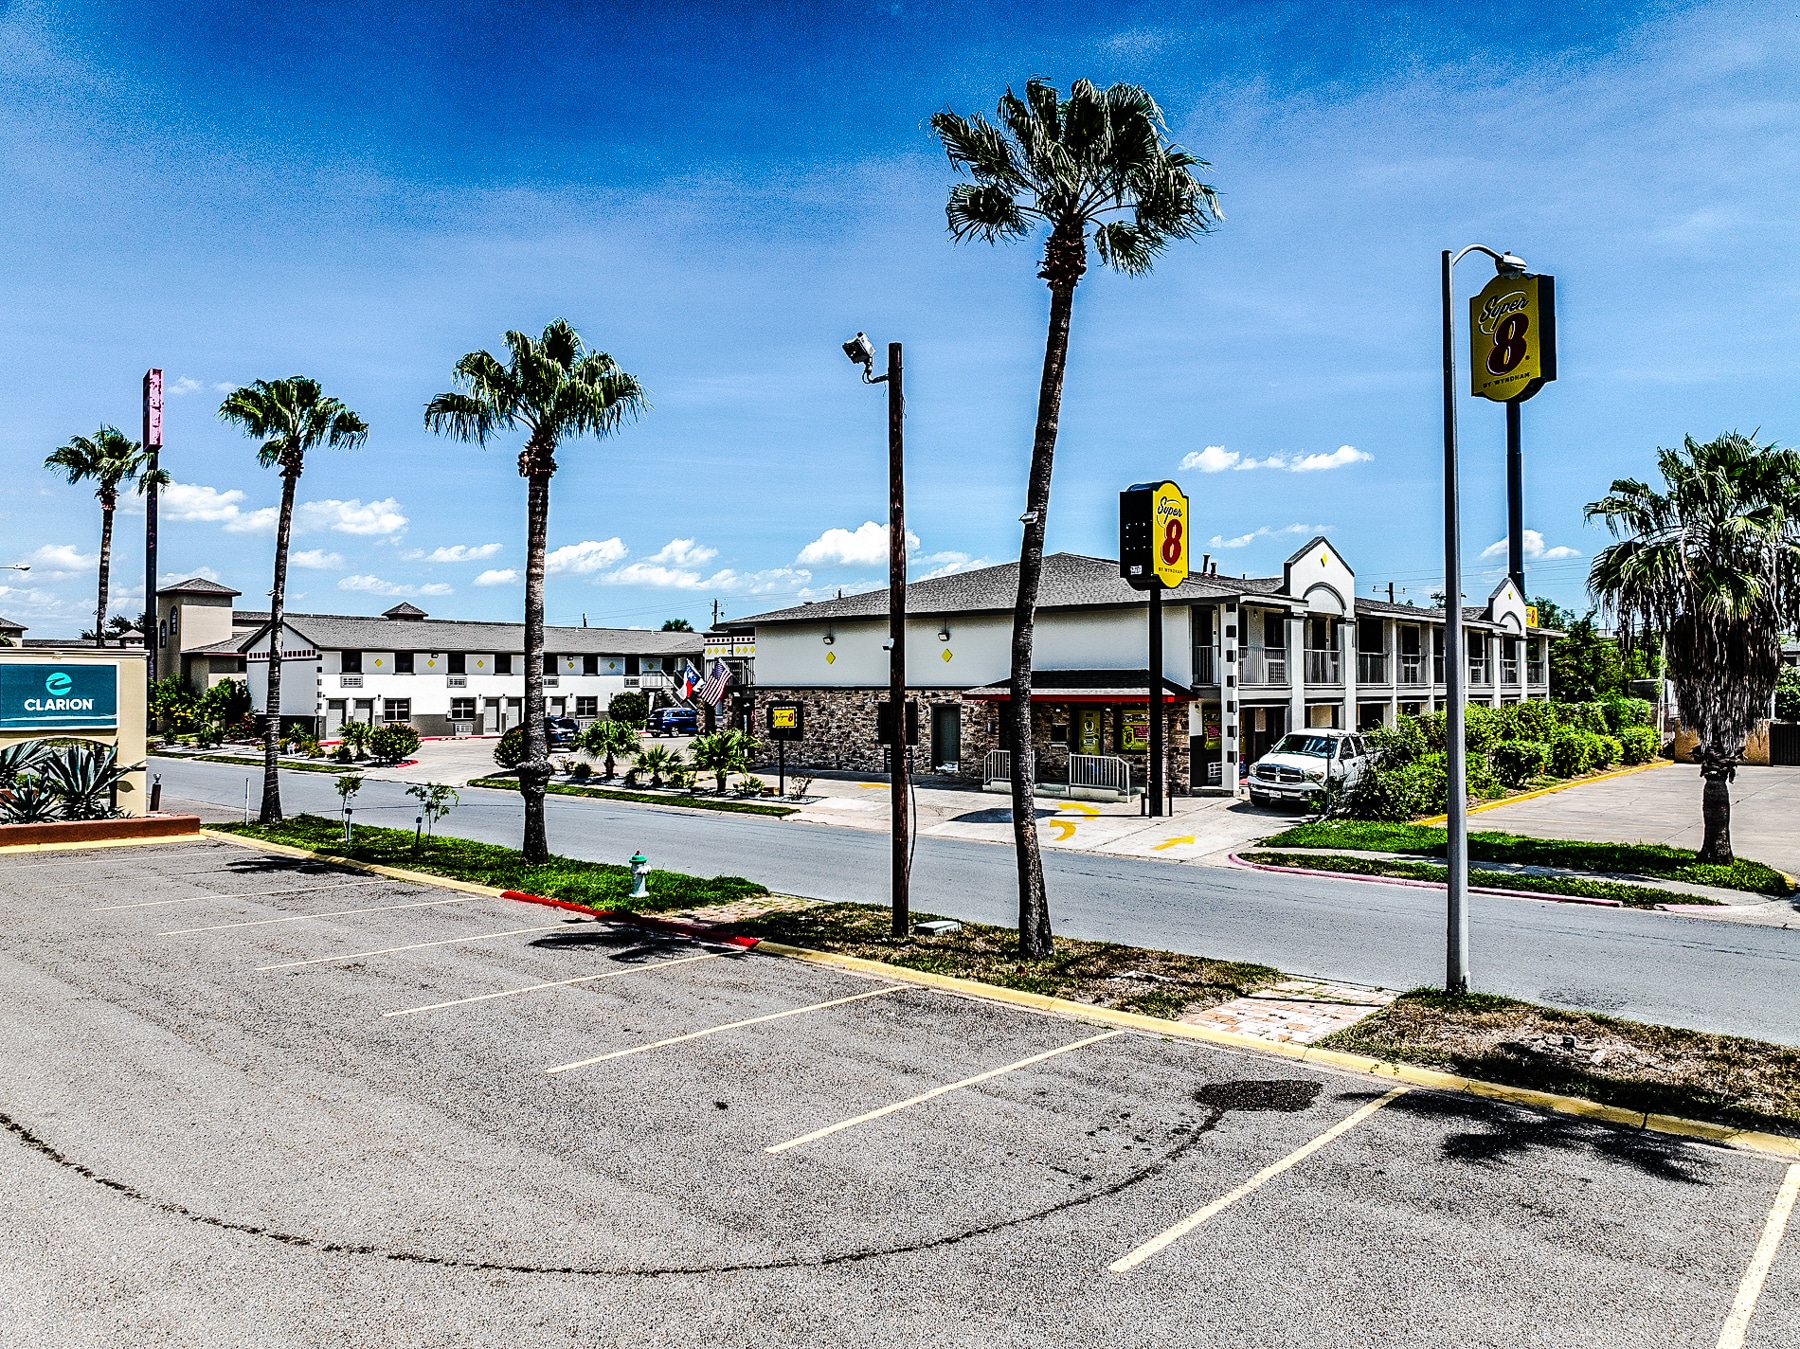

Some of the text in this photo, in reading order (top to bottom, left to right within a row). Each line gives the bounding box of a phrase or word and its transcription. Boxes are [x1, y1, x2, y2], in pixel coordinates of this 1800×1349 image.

[1479, 293, 1529, 332] Super
[1486, 312, 1529, 376] 8
[1494, 372, 1530, 385] WYNDHAM
[1157, 496, 1182, 524] Super
[1160, 519, 1182, 566] 8
[24, 698, 93, 711] CLARION
[788, 712, 793, 722] 8
